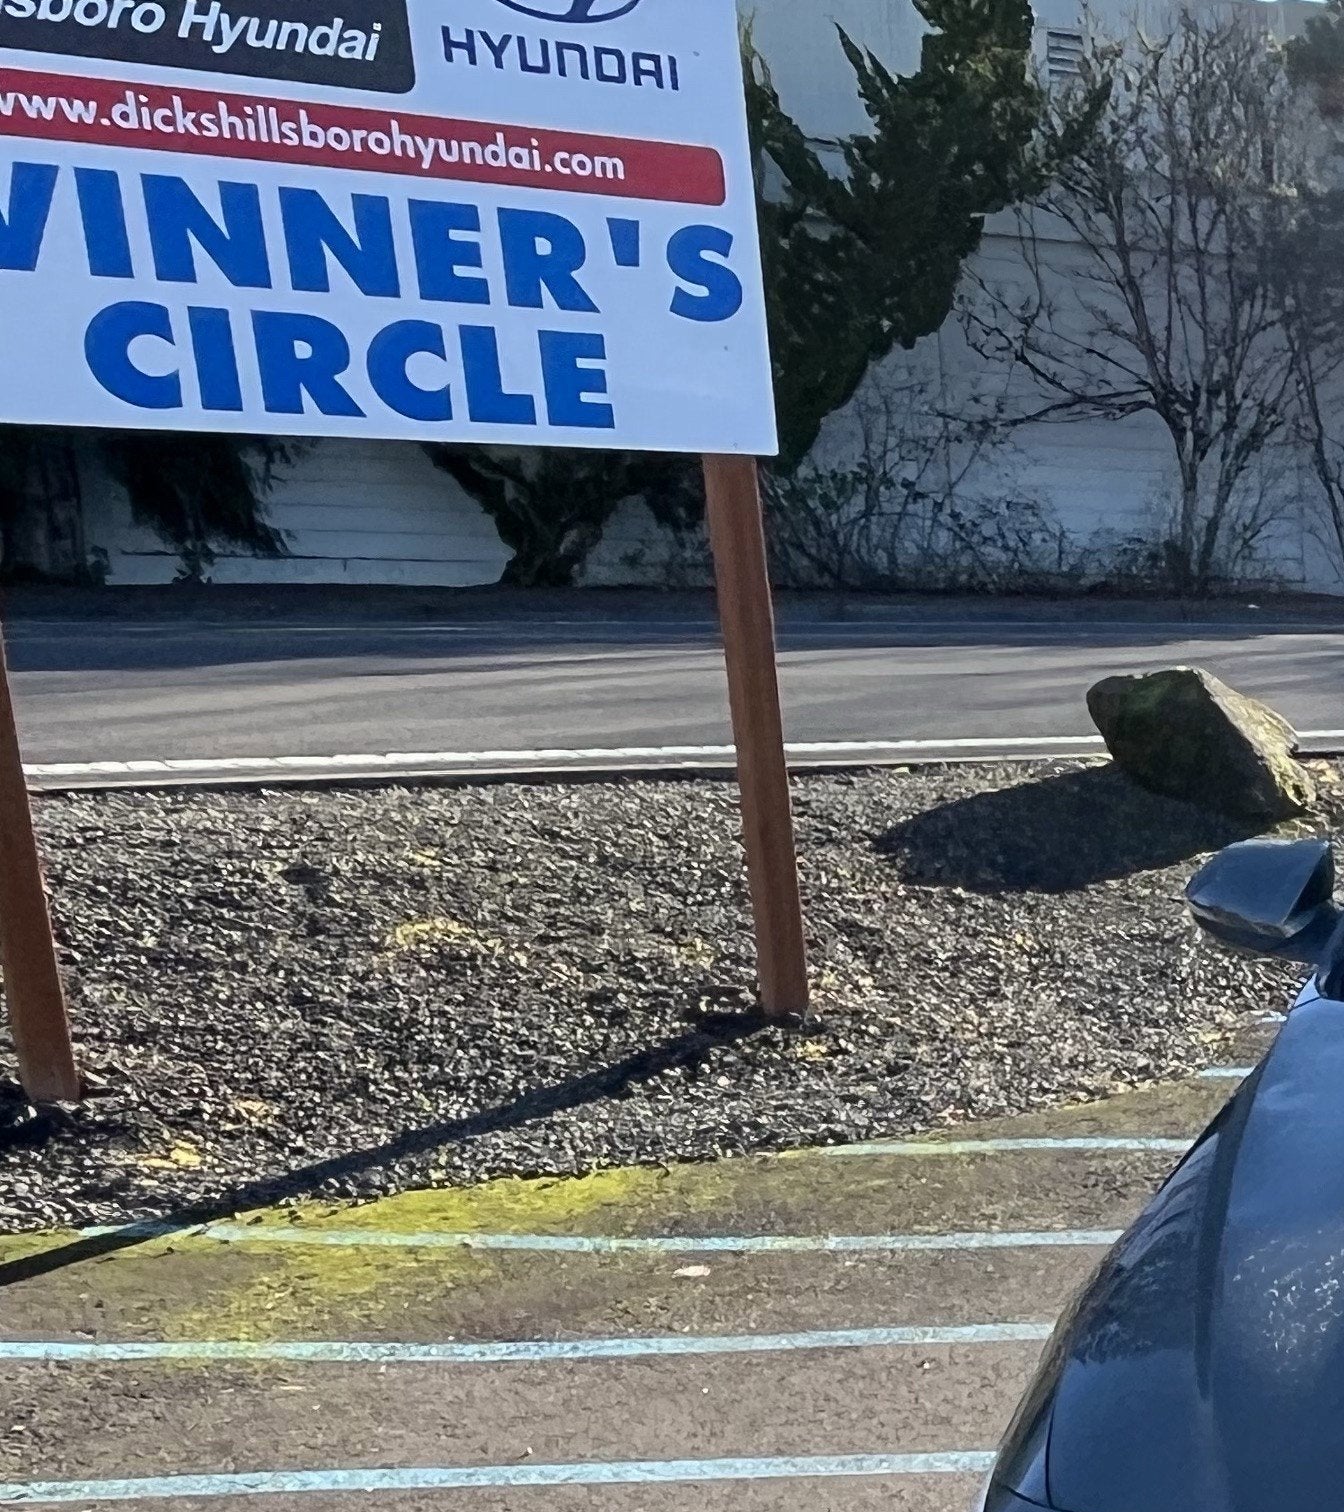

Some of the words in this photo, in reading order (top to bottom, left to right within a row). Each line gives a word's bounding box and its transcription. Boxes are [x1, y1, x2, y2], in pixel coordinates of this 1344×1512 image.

[0, 0, 166, 33] sboro
[178, 0, 381, 61] Hyundai
[441, 25, 679, 91] HYUNDAI
[84, 301, 616, 429] CIRCLE
